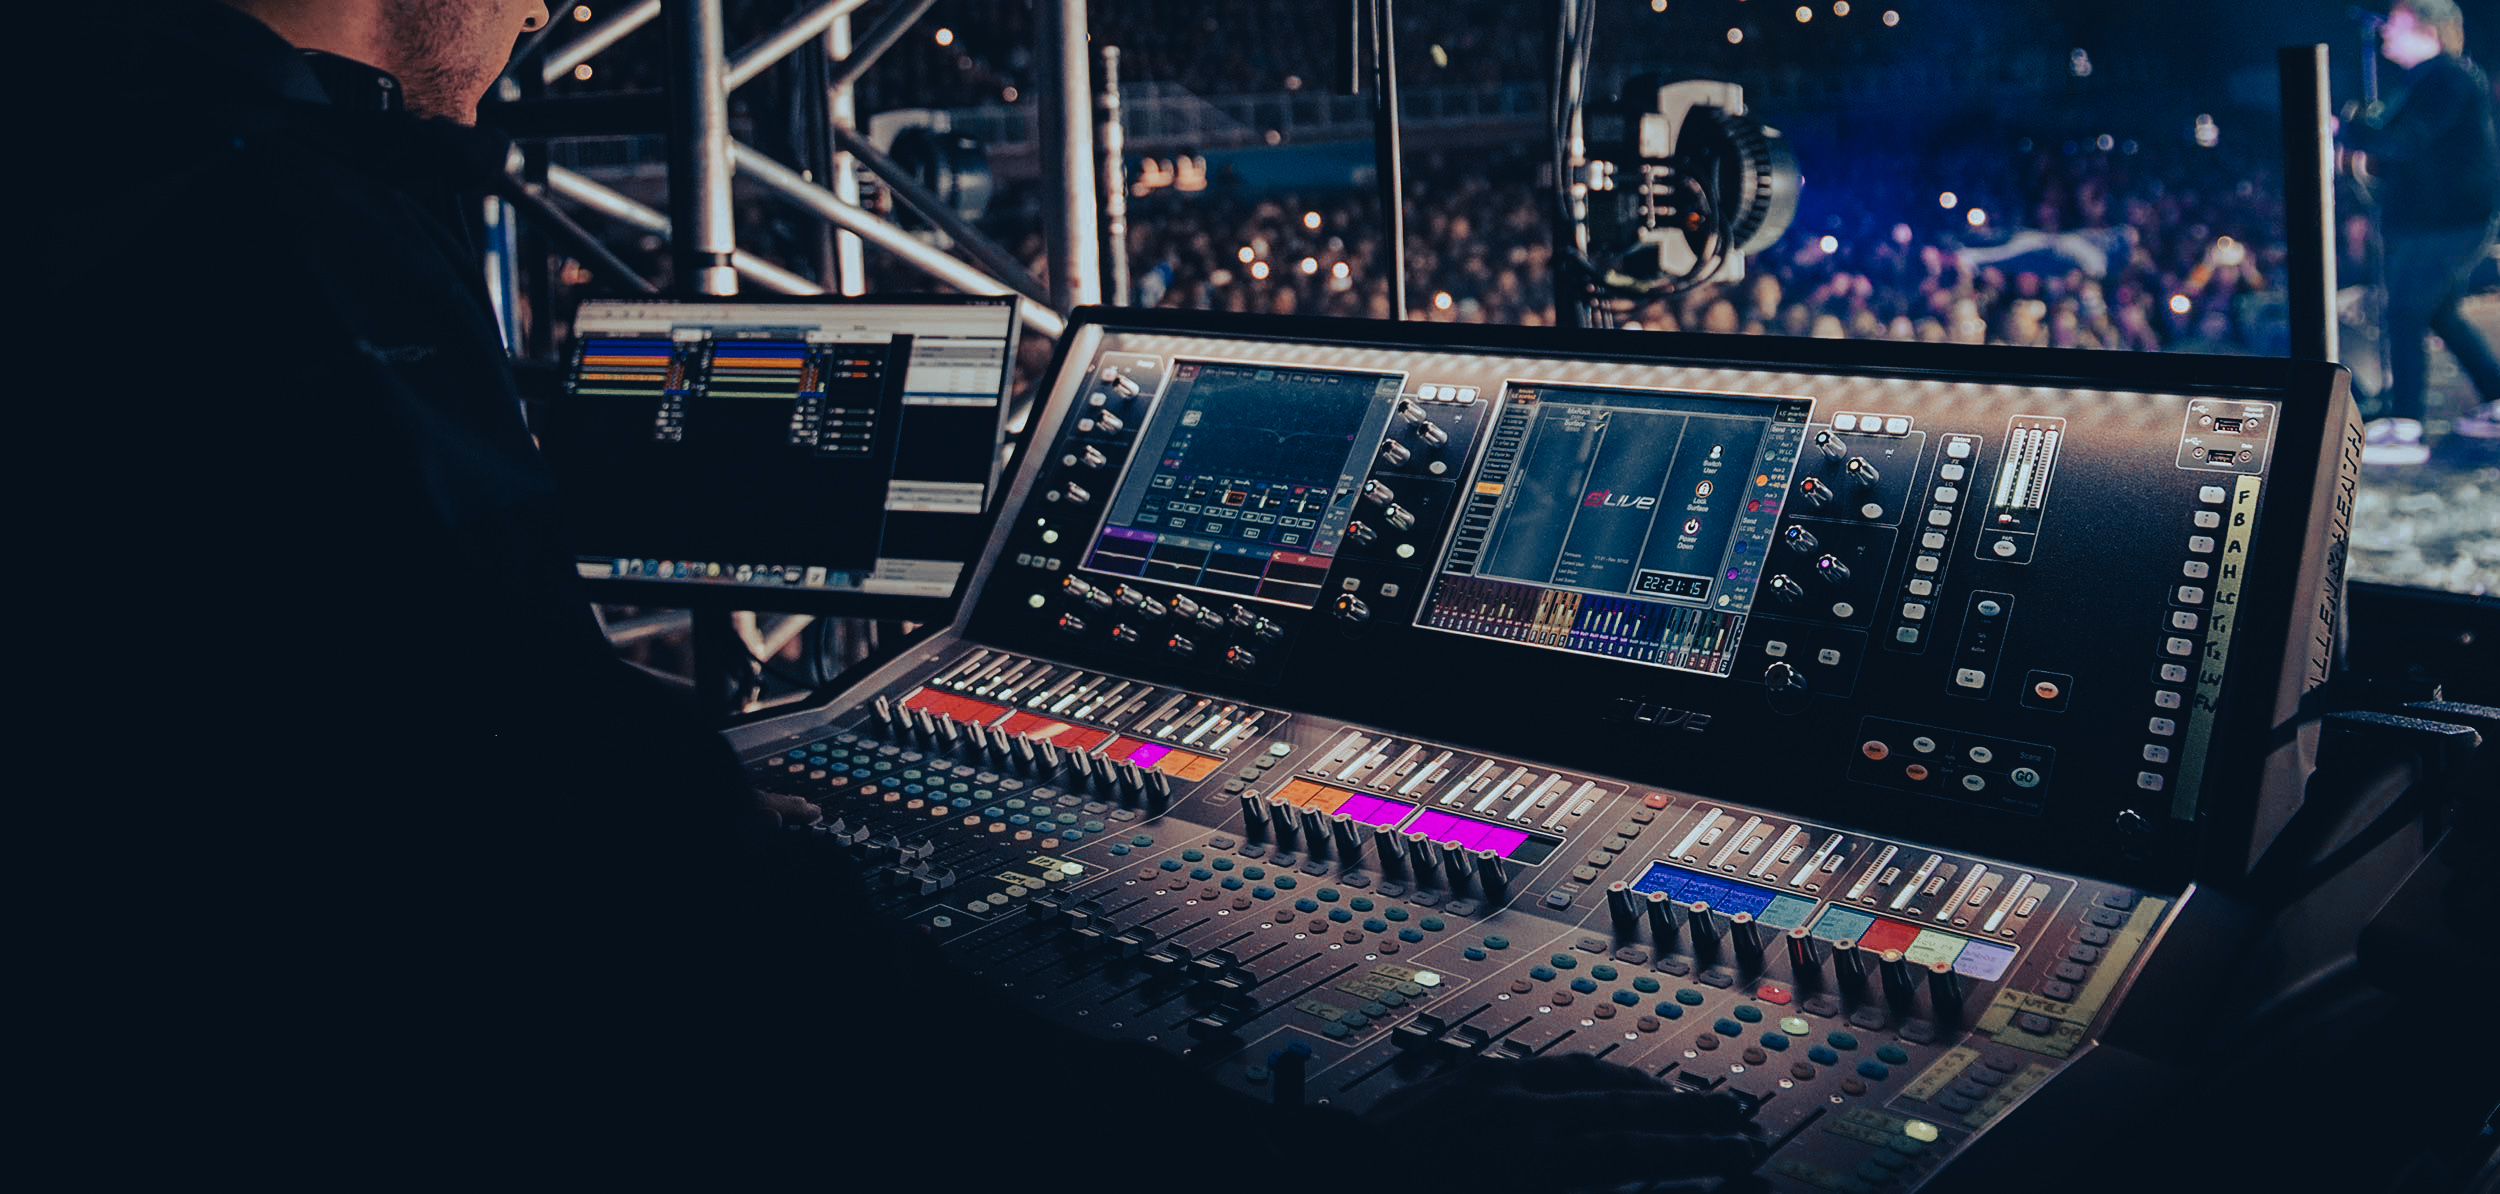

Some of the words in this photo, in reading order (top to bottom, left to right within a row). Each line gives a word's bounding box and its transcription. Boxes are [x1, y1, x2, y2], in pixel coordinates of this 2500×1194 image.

[2238, 490, 2251, 505] F
[2233, 512, 2246, 527] B
[2227, 540, 2242, 554] A
[2222, 564, 2237, 579] H
[1643, 576, 1702, 596] 22:21:15
[2216, 590, 2237, 605] LC
[2205, 641, 2222, 661] T2
[2015, 770, 2034, 783] GO
